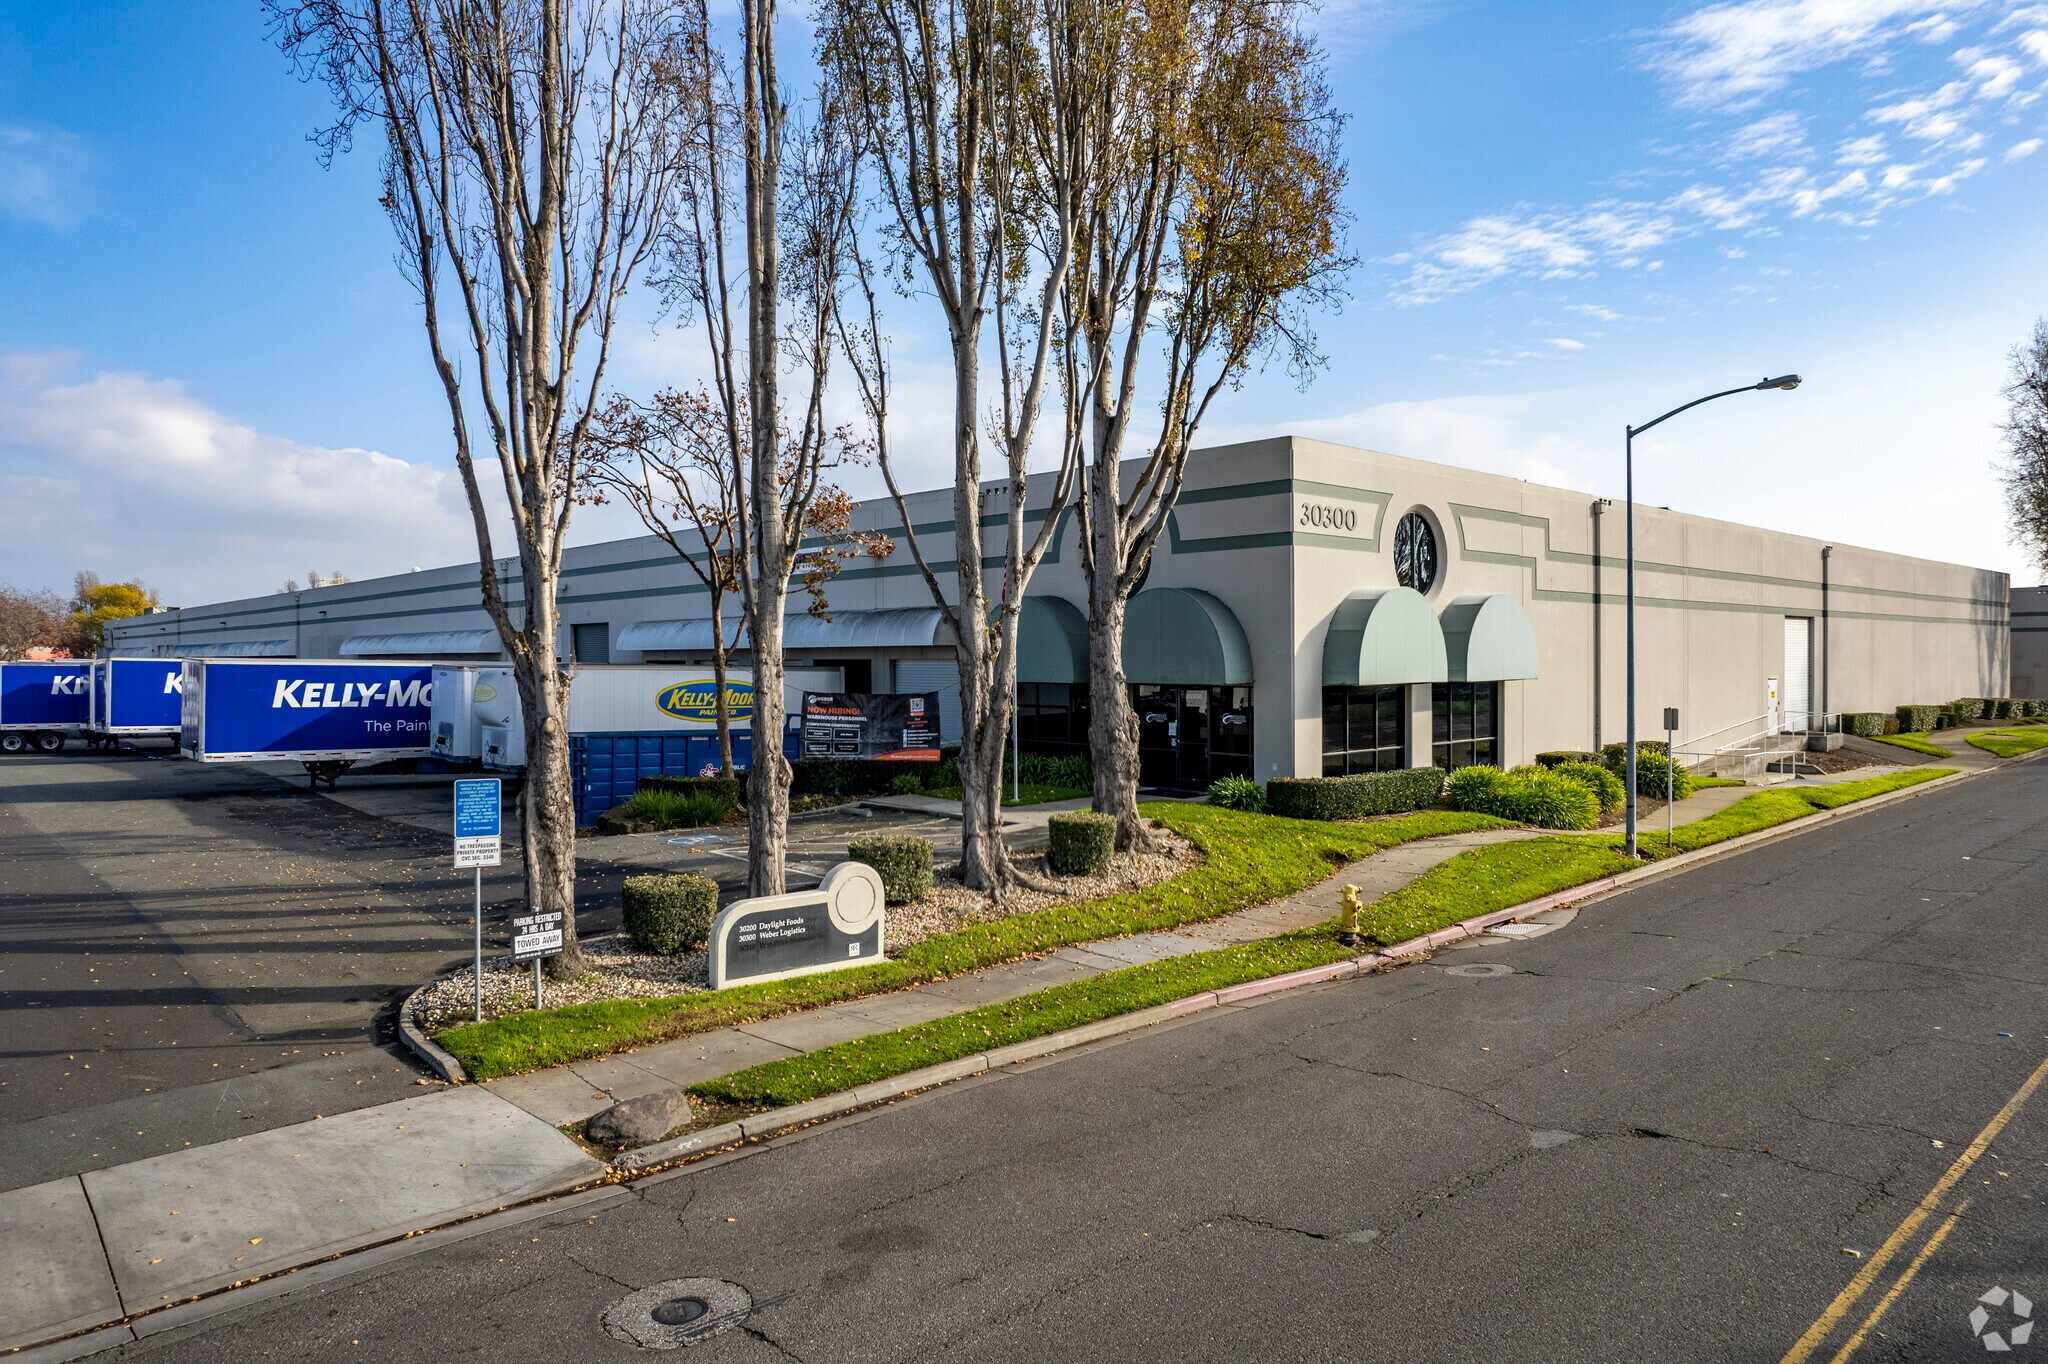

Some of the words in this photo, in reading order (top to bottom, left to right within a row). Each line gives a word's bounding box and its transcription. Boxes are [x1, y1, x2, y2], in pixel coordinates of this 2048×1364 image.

[1300, 502, 1357, 531] 30300
[364, 720, 391, 732] The
[514, 916, 534, 927] PARKING
[535, 912, 561, 924] RESTRICTED
[739, 924, 757, 933] 30200
[759, 919, 785, 931] Daylight
[786, 917, 804, 925] Foods
[522, 926, 528, 934] 24
[529, 924, 538, 933] HRS
[545, 922, 554, 931] DAY
[739, 934, 756, 943] 30300
[780, 927, 805, 936] Logistics
[517, 938, 540, 948] TOWED
[542, 934, 560, 944] AWAY
